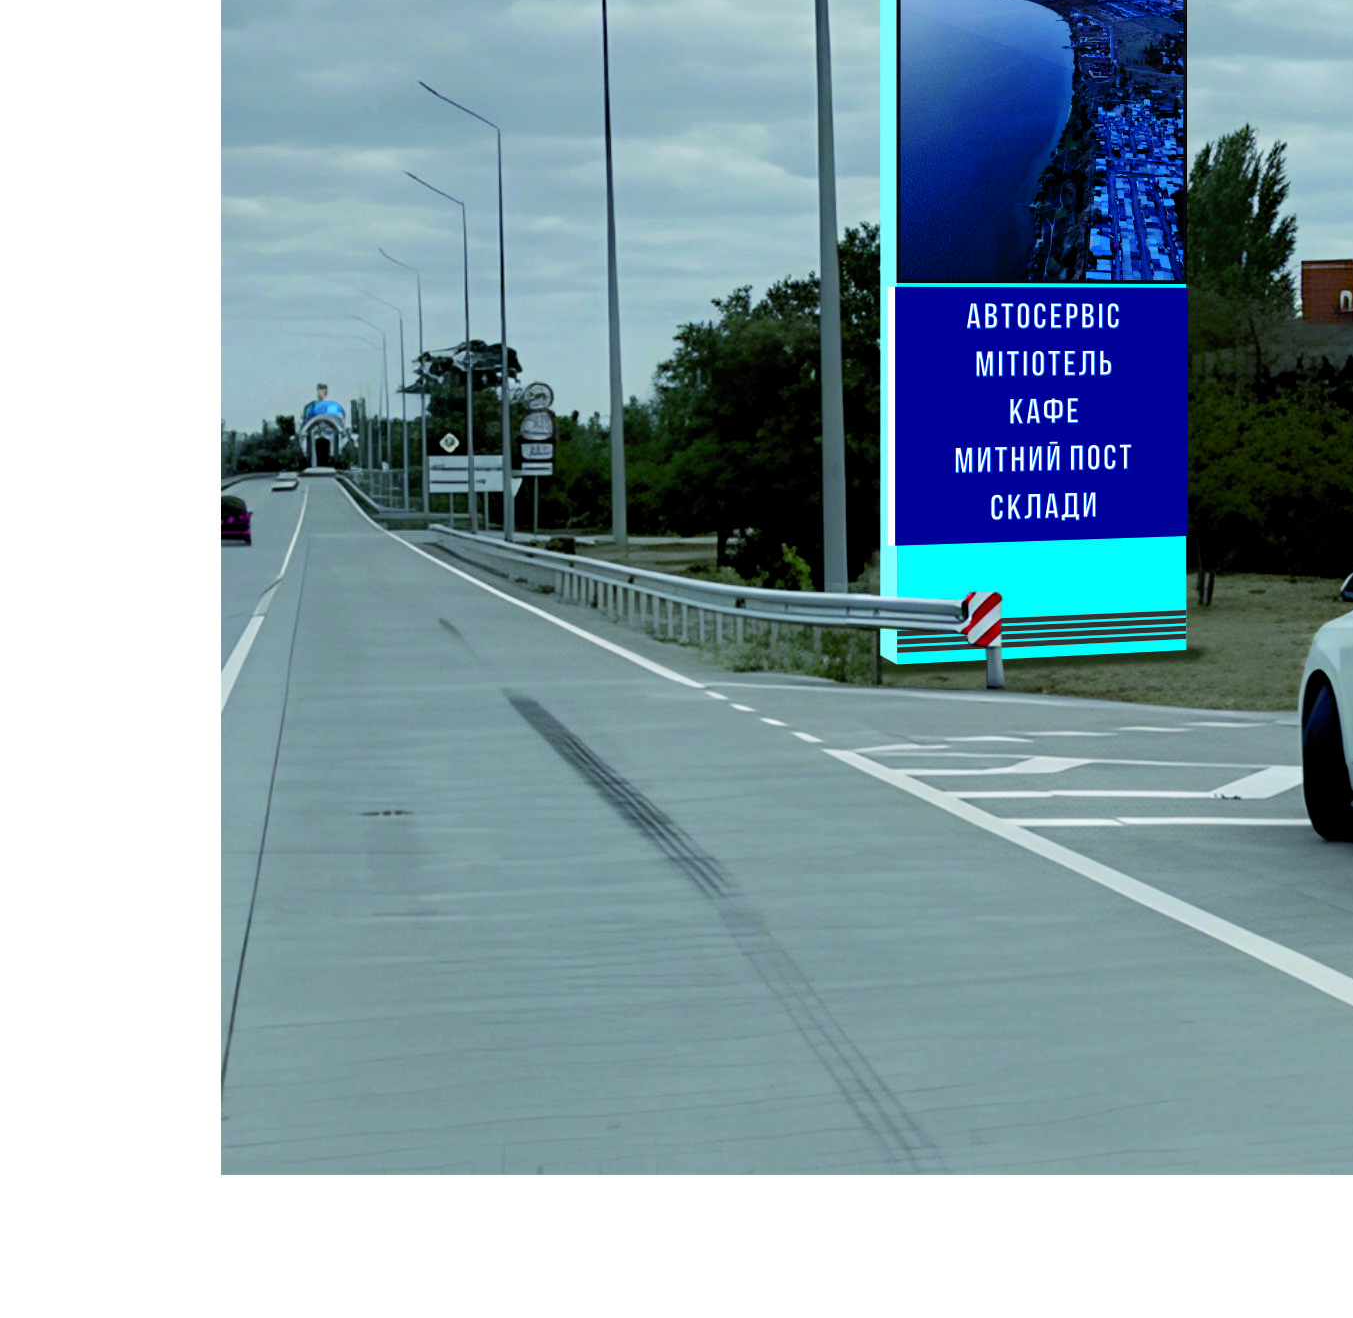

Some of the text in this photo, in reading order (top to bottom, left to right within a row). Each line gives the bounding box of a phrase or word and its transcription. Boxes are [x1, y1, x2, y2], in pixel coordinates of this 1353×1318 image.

[966, 302, 1119, 329] АВТОСЕРВІС
[976, 350, 1112, 377] МІТІОТЕЛЬ
[1009, 397, 1078, 424] КАФЕ
[955, 441, 1132, 473] МИТНИЙ ПОСТ
[990, 492, 1096, 521] СКЛАДИ
